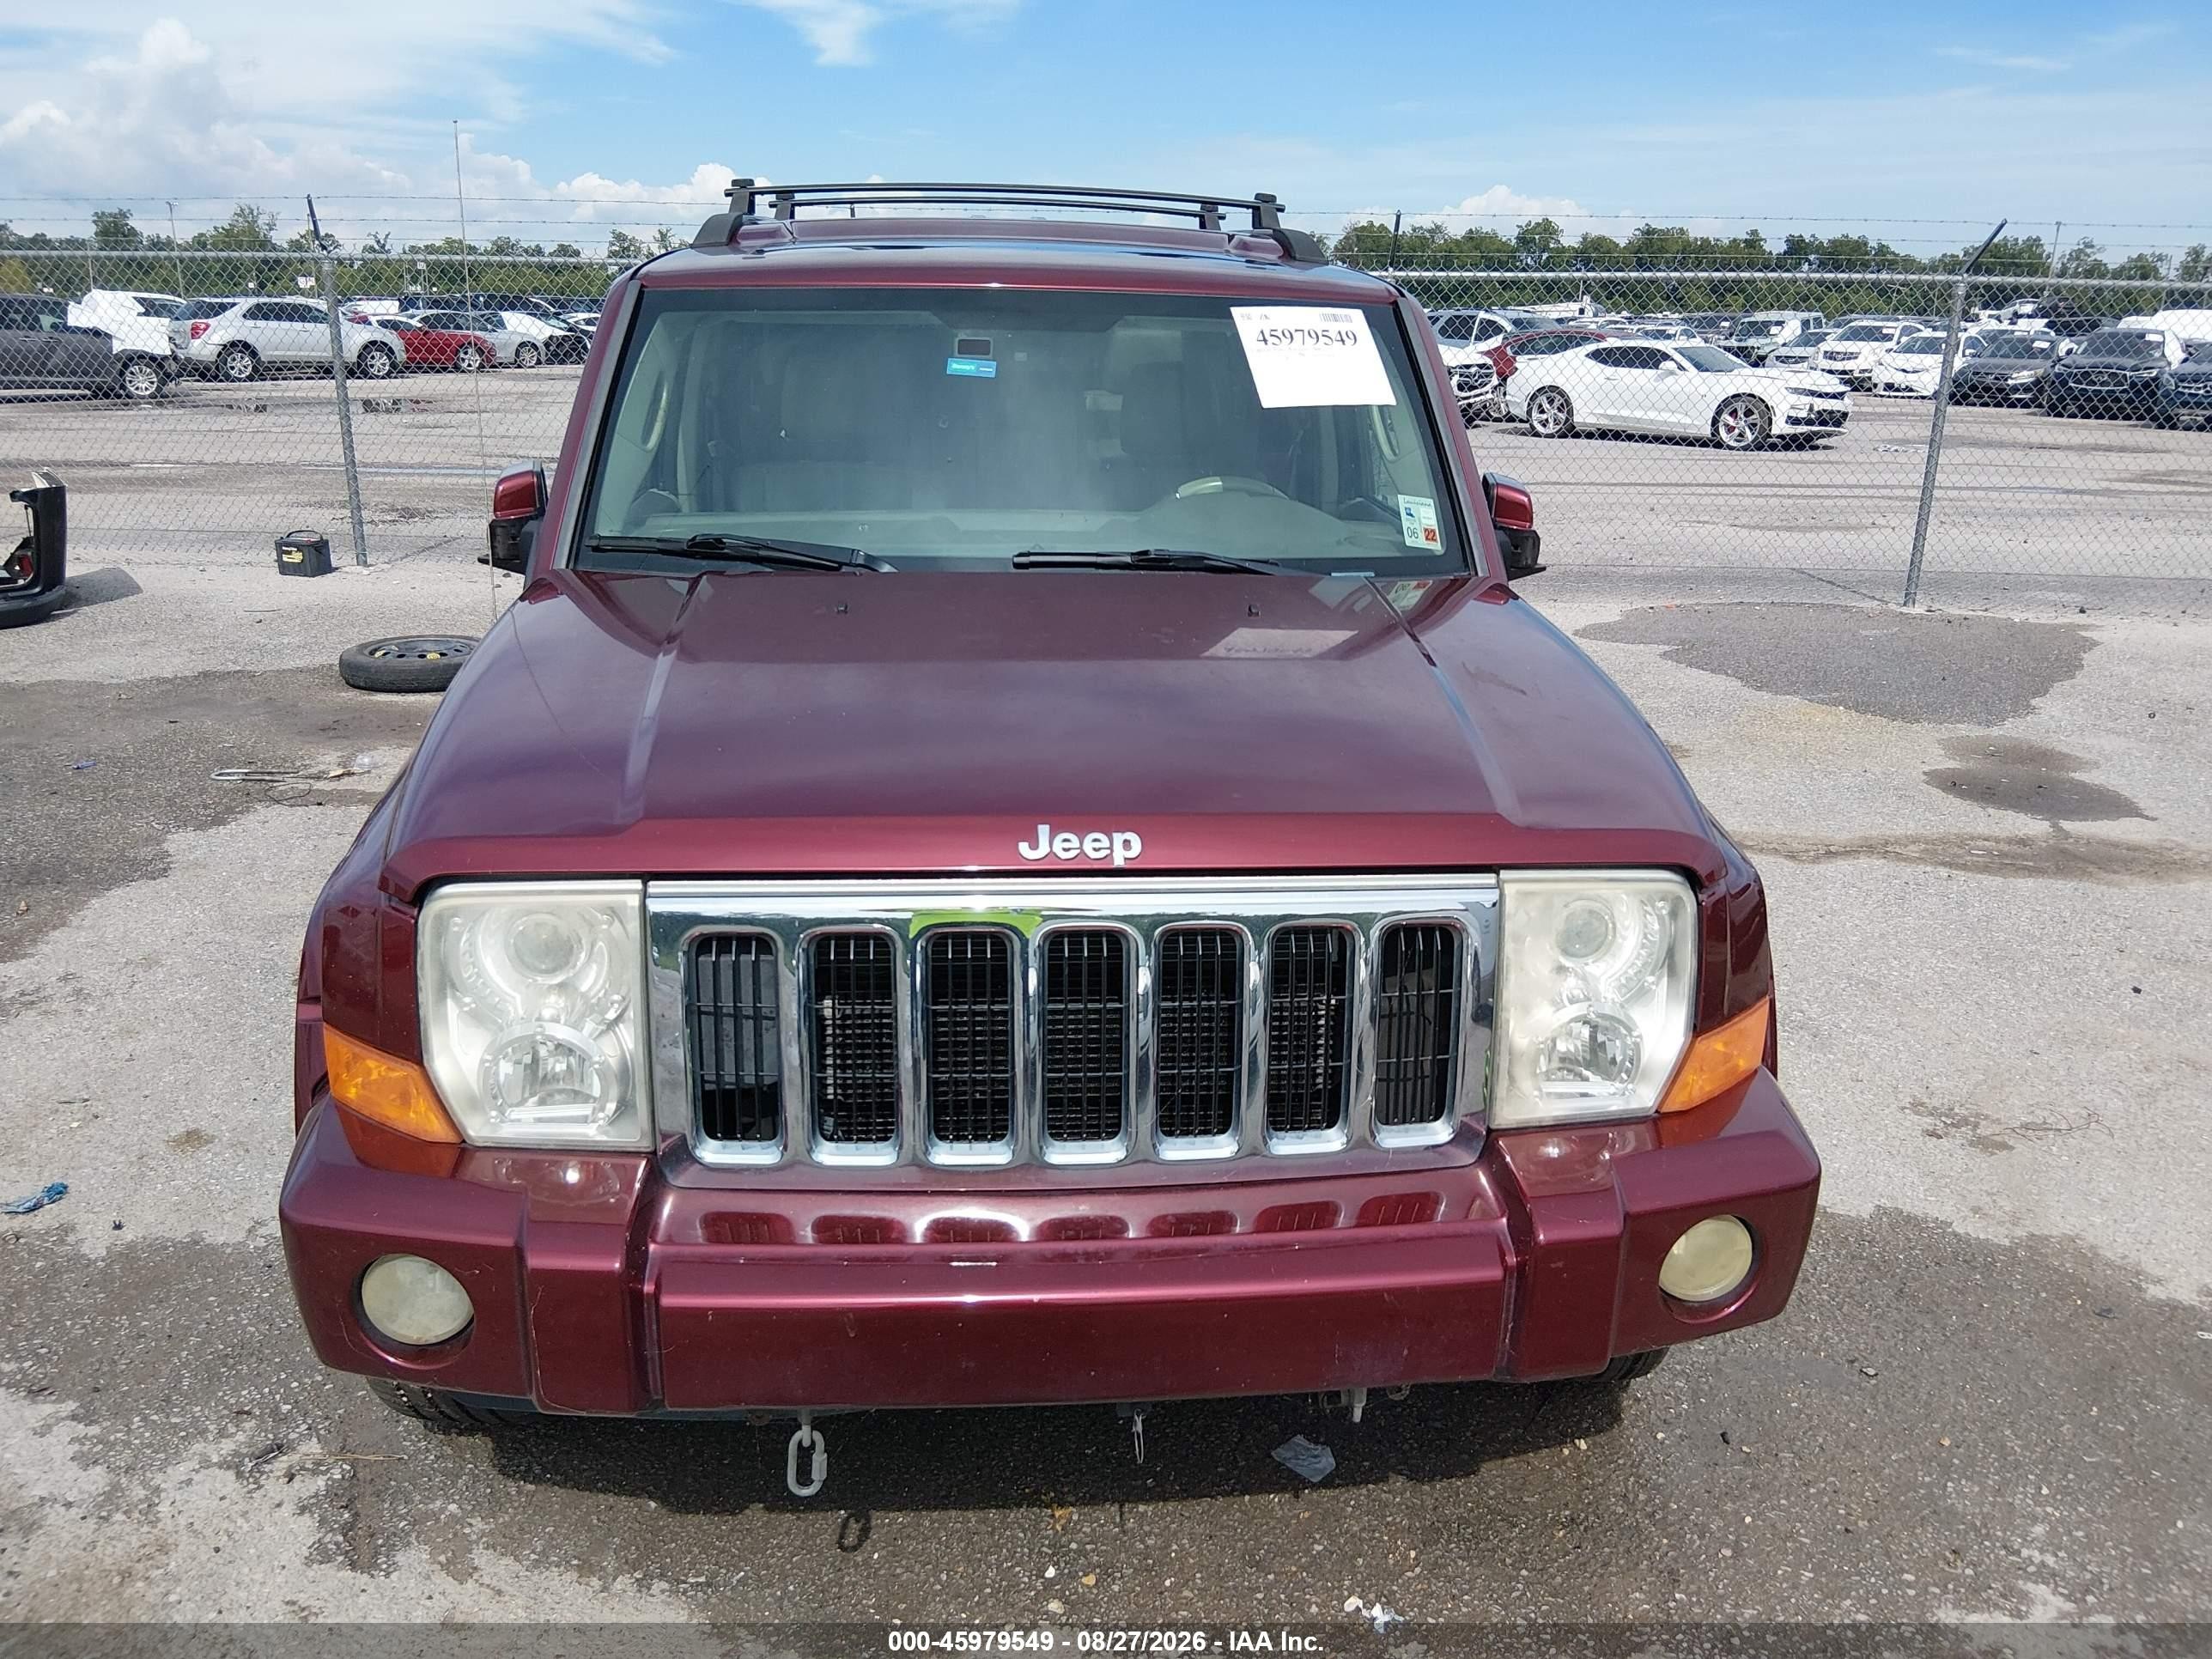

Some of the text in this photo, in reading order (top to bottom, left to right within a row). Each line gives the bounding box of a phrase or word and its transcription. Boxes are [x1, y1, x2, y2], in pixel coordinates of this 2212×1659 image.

[1256, 328, 1358, 346] 45979549
[1407, 526, 1437, 541] 06 22
[1018, 824, 1142, 866] Jeep
